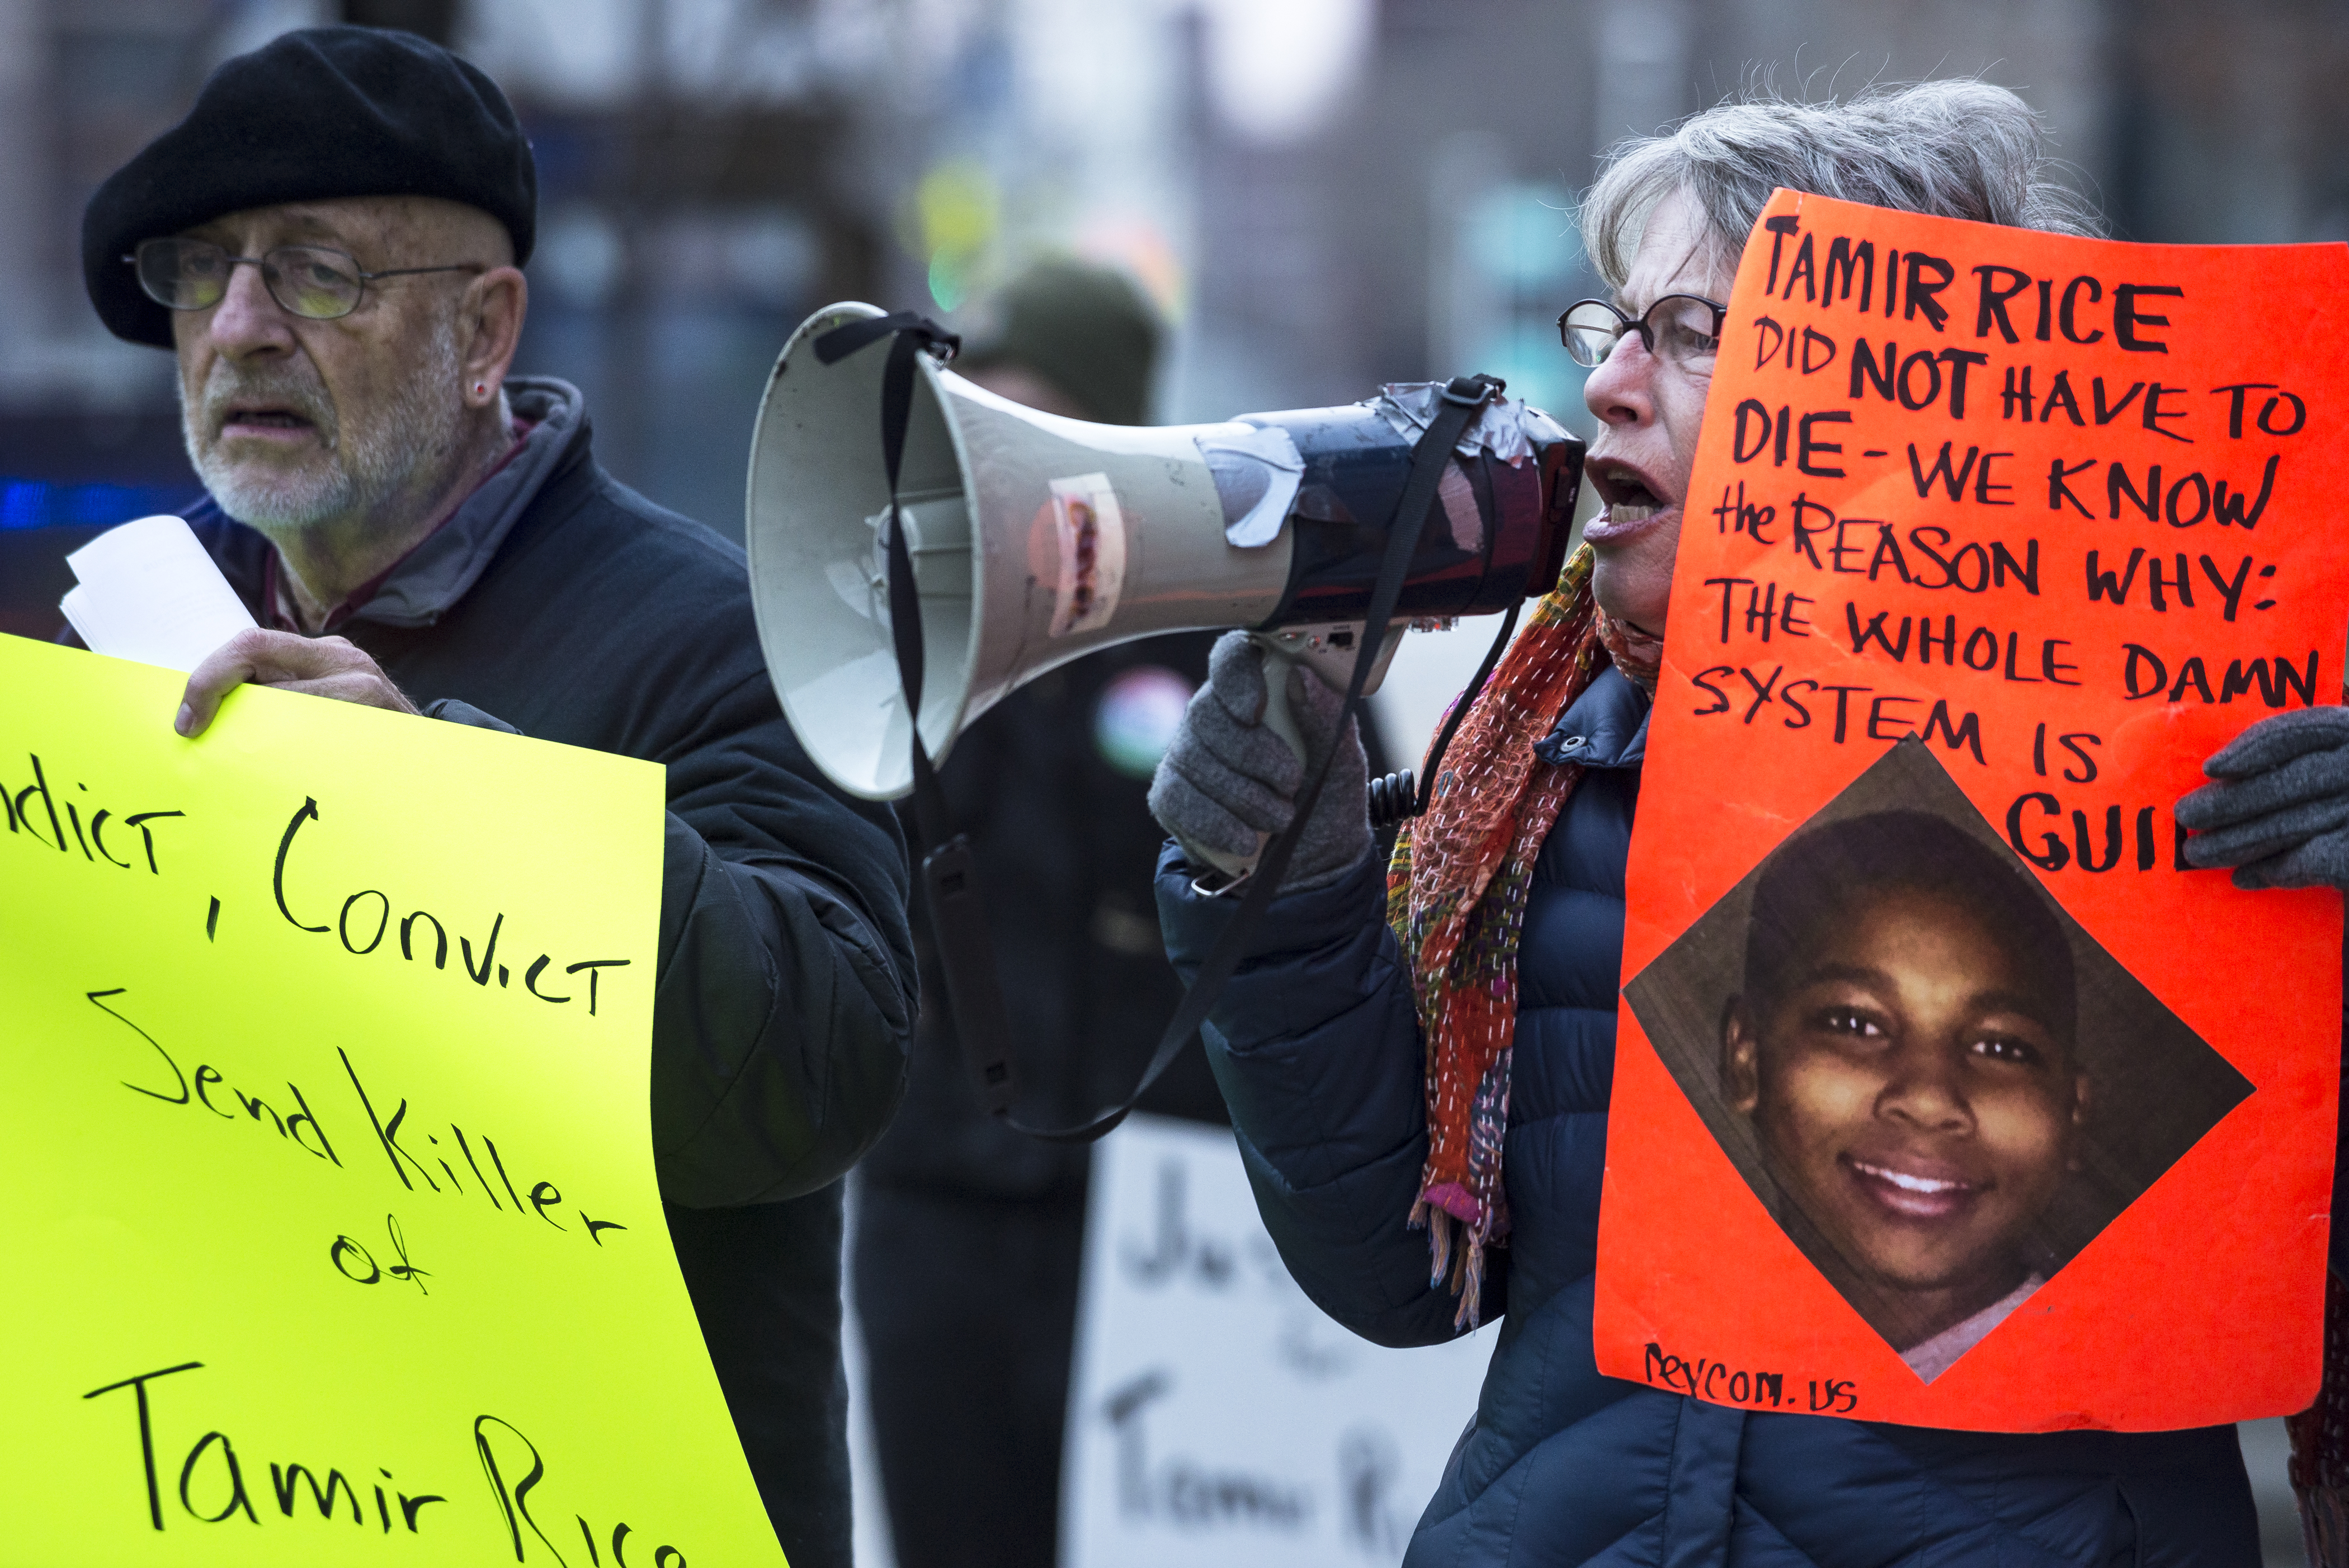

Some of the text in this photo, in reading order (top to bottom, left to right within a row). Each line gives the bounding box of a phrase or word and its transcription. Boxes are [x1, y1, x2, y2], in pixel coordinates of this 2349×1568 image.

[1764, 216, 2185, 354] TAMIR RICE
[1754, 316, 2307, 444] DID NOT HAVE TO
[1908, 441, 2015, 506] WE
[2047, 454, 2281, 530] KNOW
[1713, 481, 2277, 622] the REASON WHY:
[1704, 578, 2320, 708] THE WHOLE DAMN
[1692, 665, 2101, 783] SYSTEM IS
[2006, 792, 2201, 872] GUI
[87, 988, 343, 1169] Send
[331, 1213, 434, 1296] of
[83, 1362, 448, 1534] Tamir
